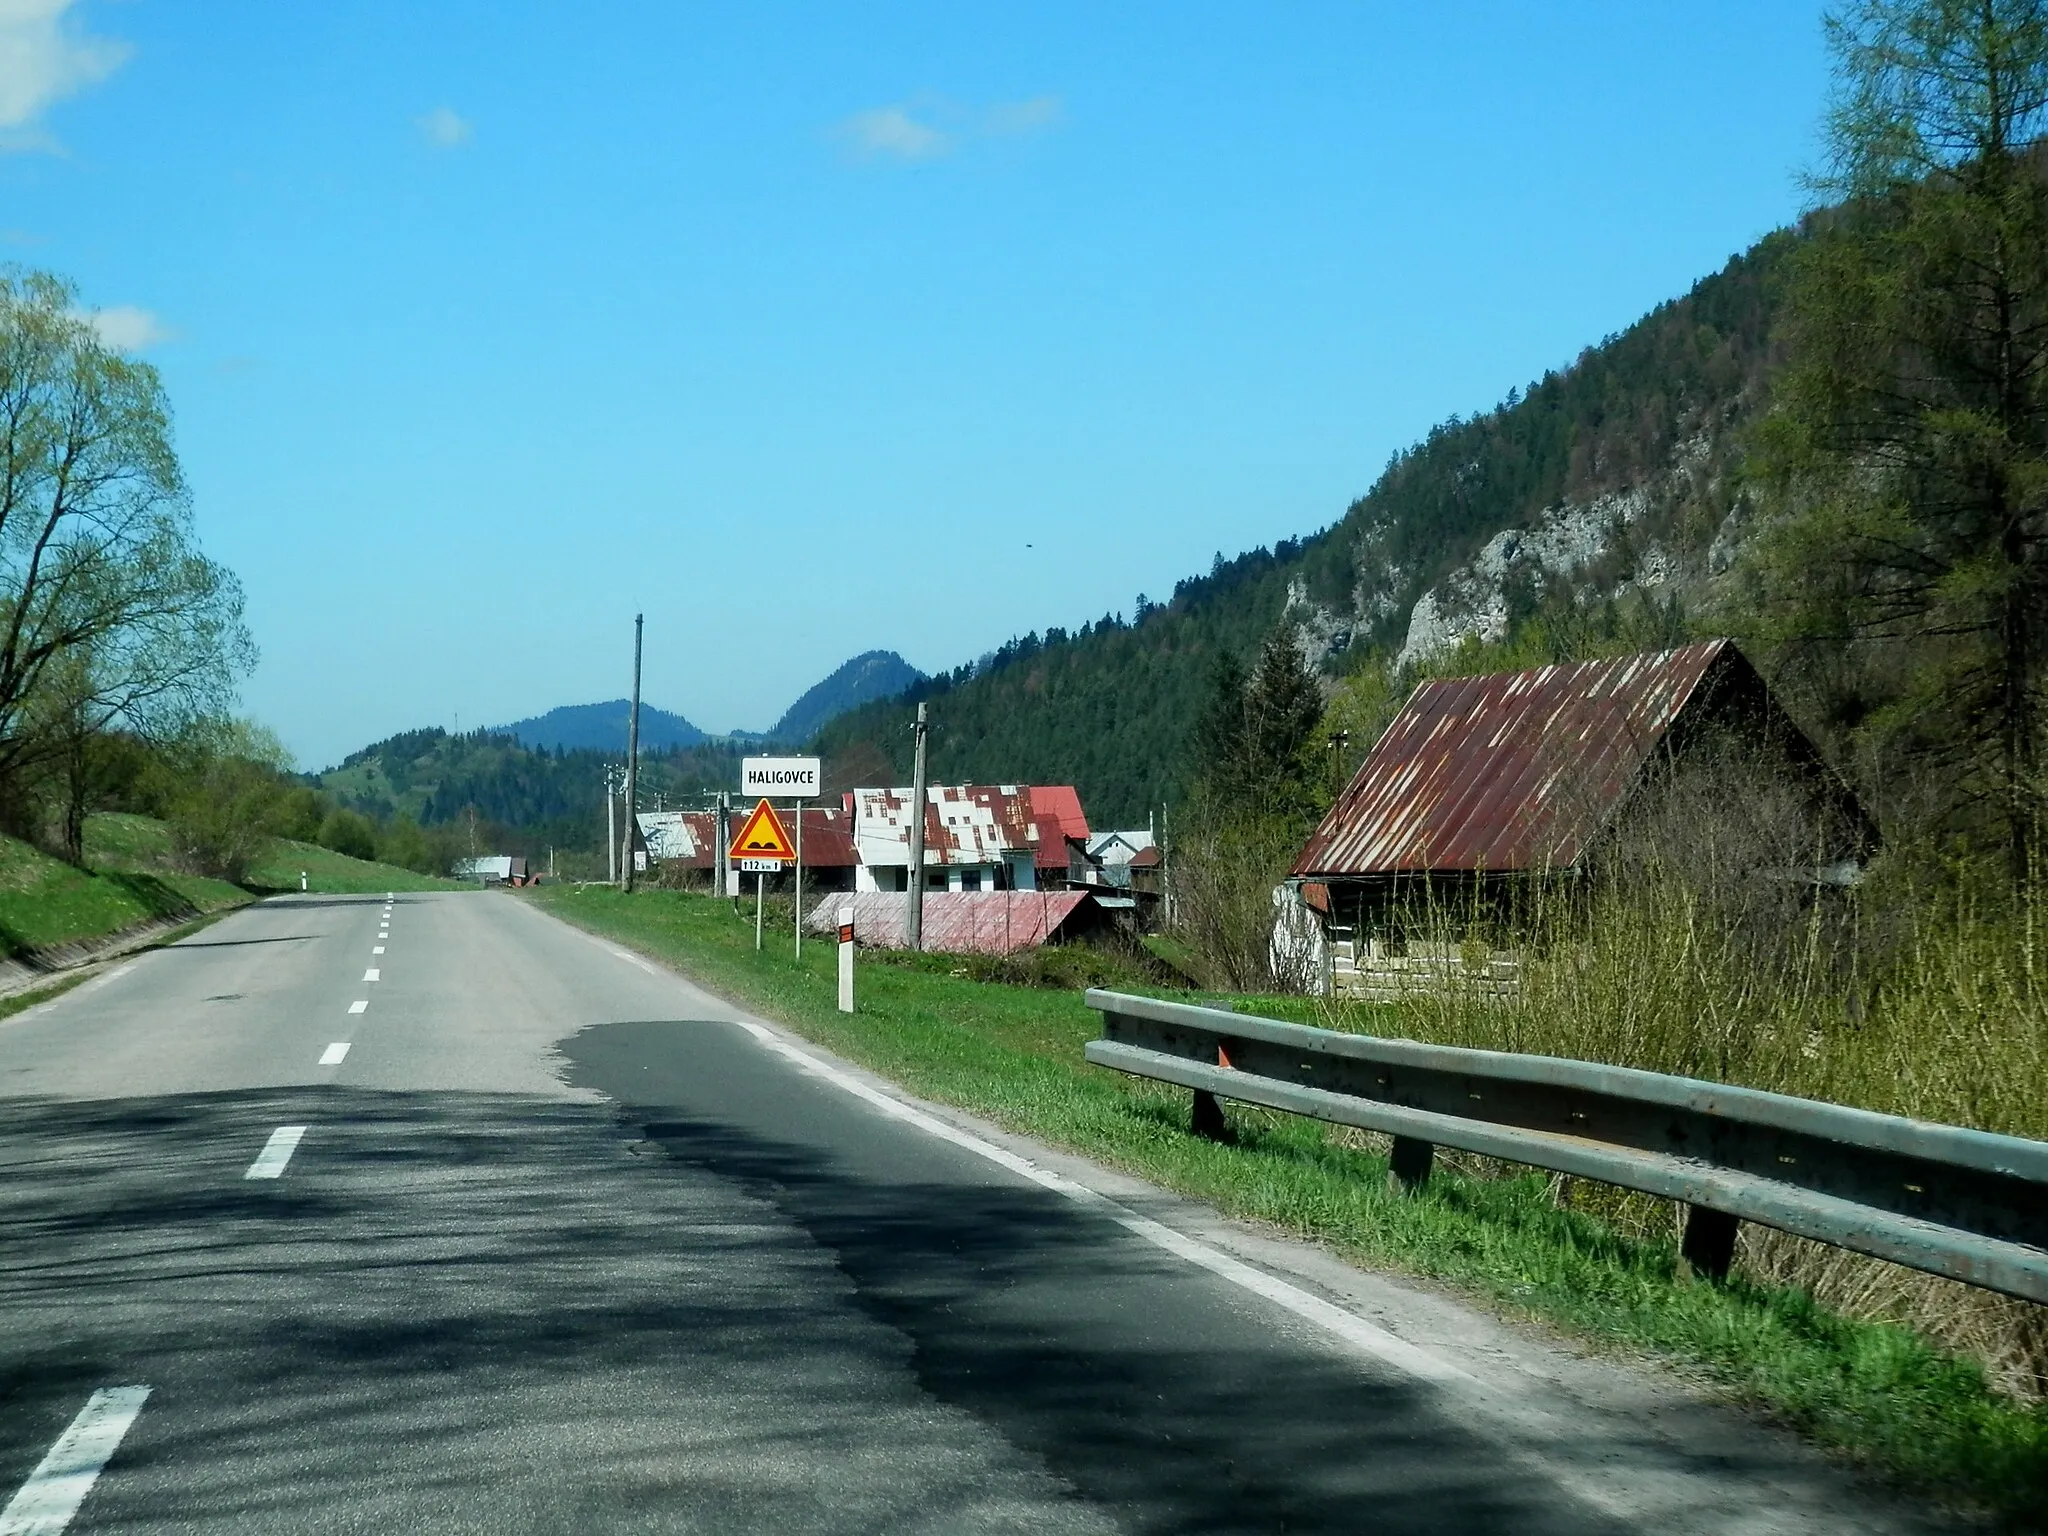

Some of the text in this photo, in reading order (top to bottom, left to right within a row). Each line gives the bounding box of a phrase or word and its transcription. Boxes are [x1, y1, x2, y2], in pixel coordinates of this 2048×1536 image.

[749, 771, 813, 783] HALIGOVCE
[749, 861, 771, 870] 12 km
